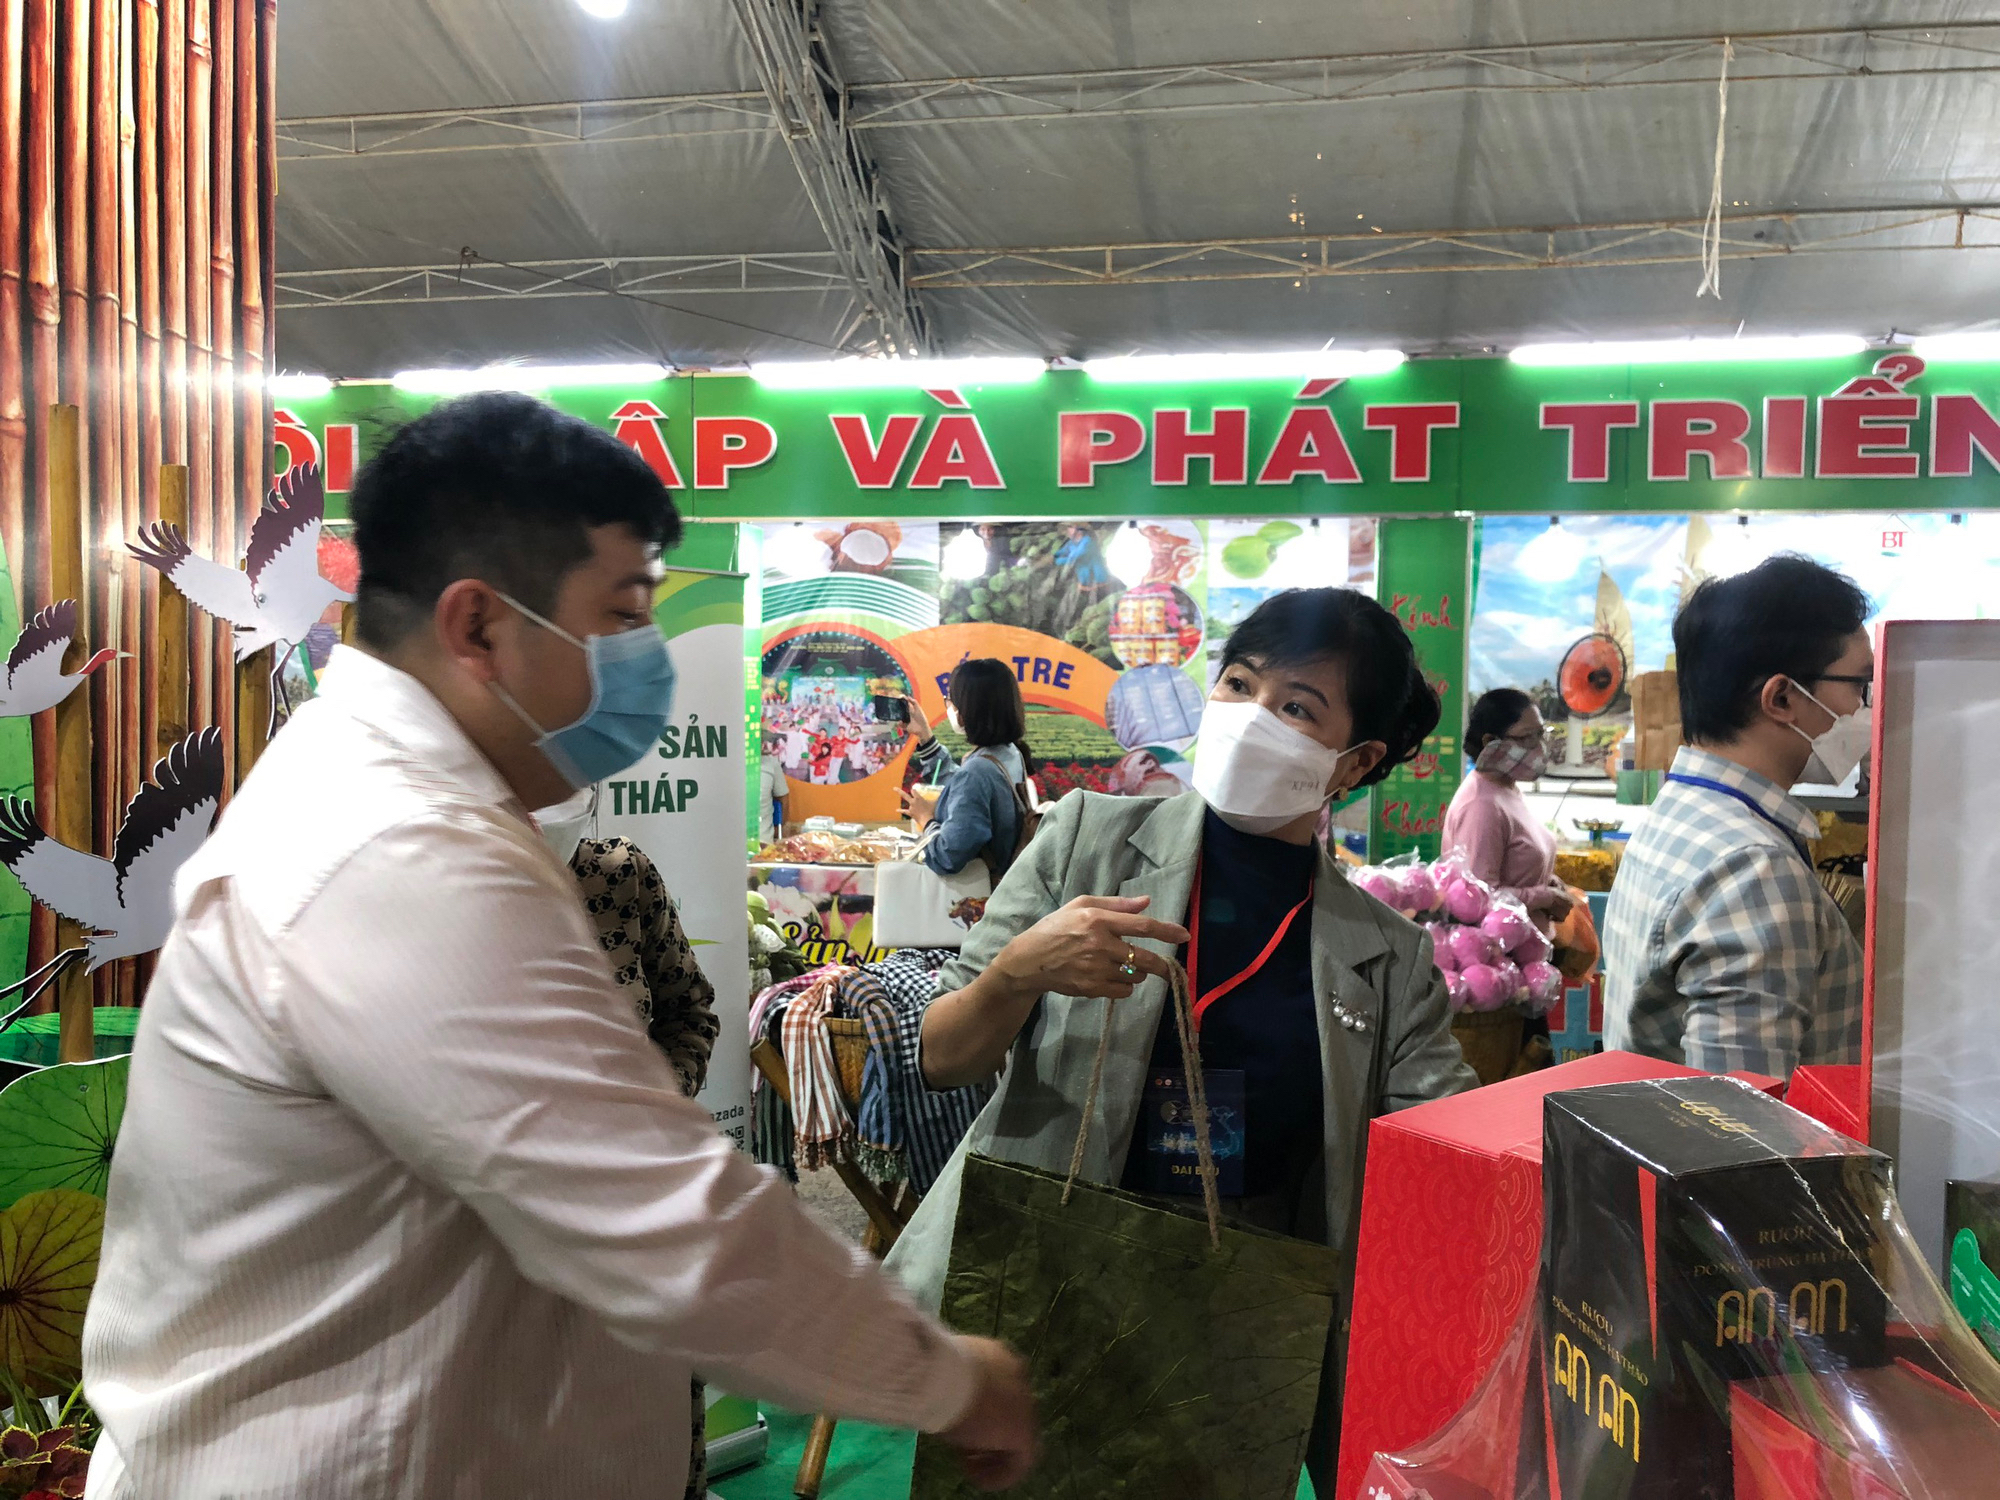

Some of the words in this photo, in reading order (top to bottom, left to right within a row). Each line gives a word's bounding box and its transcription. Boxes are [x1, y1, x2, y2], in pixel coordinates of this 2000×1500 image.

[829, 388, 1006, 488] VÀ
[1057, 377, 1460, 487] PHÁT
[1540, 353, 2000, 482] TRIỂN
[1012, 656, 1075, 690] TRE
[658, 713, 728, 759] SẢN
[609, 772, 699, 816] THÁP
